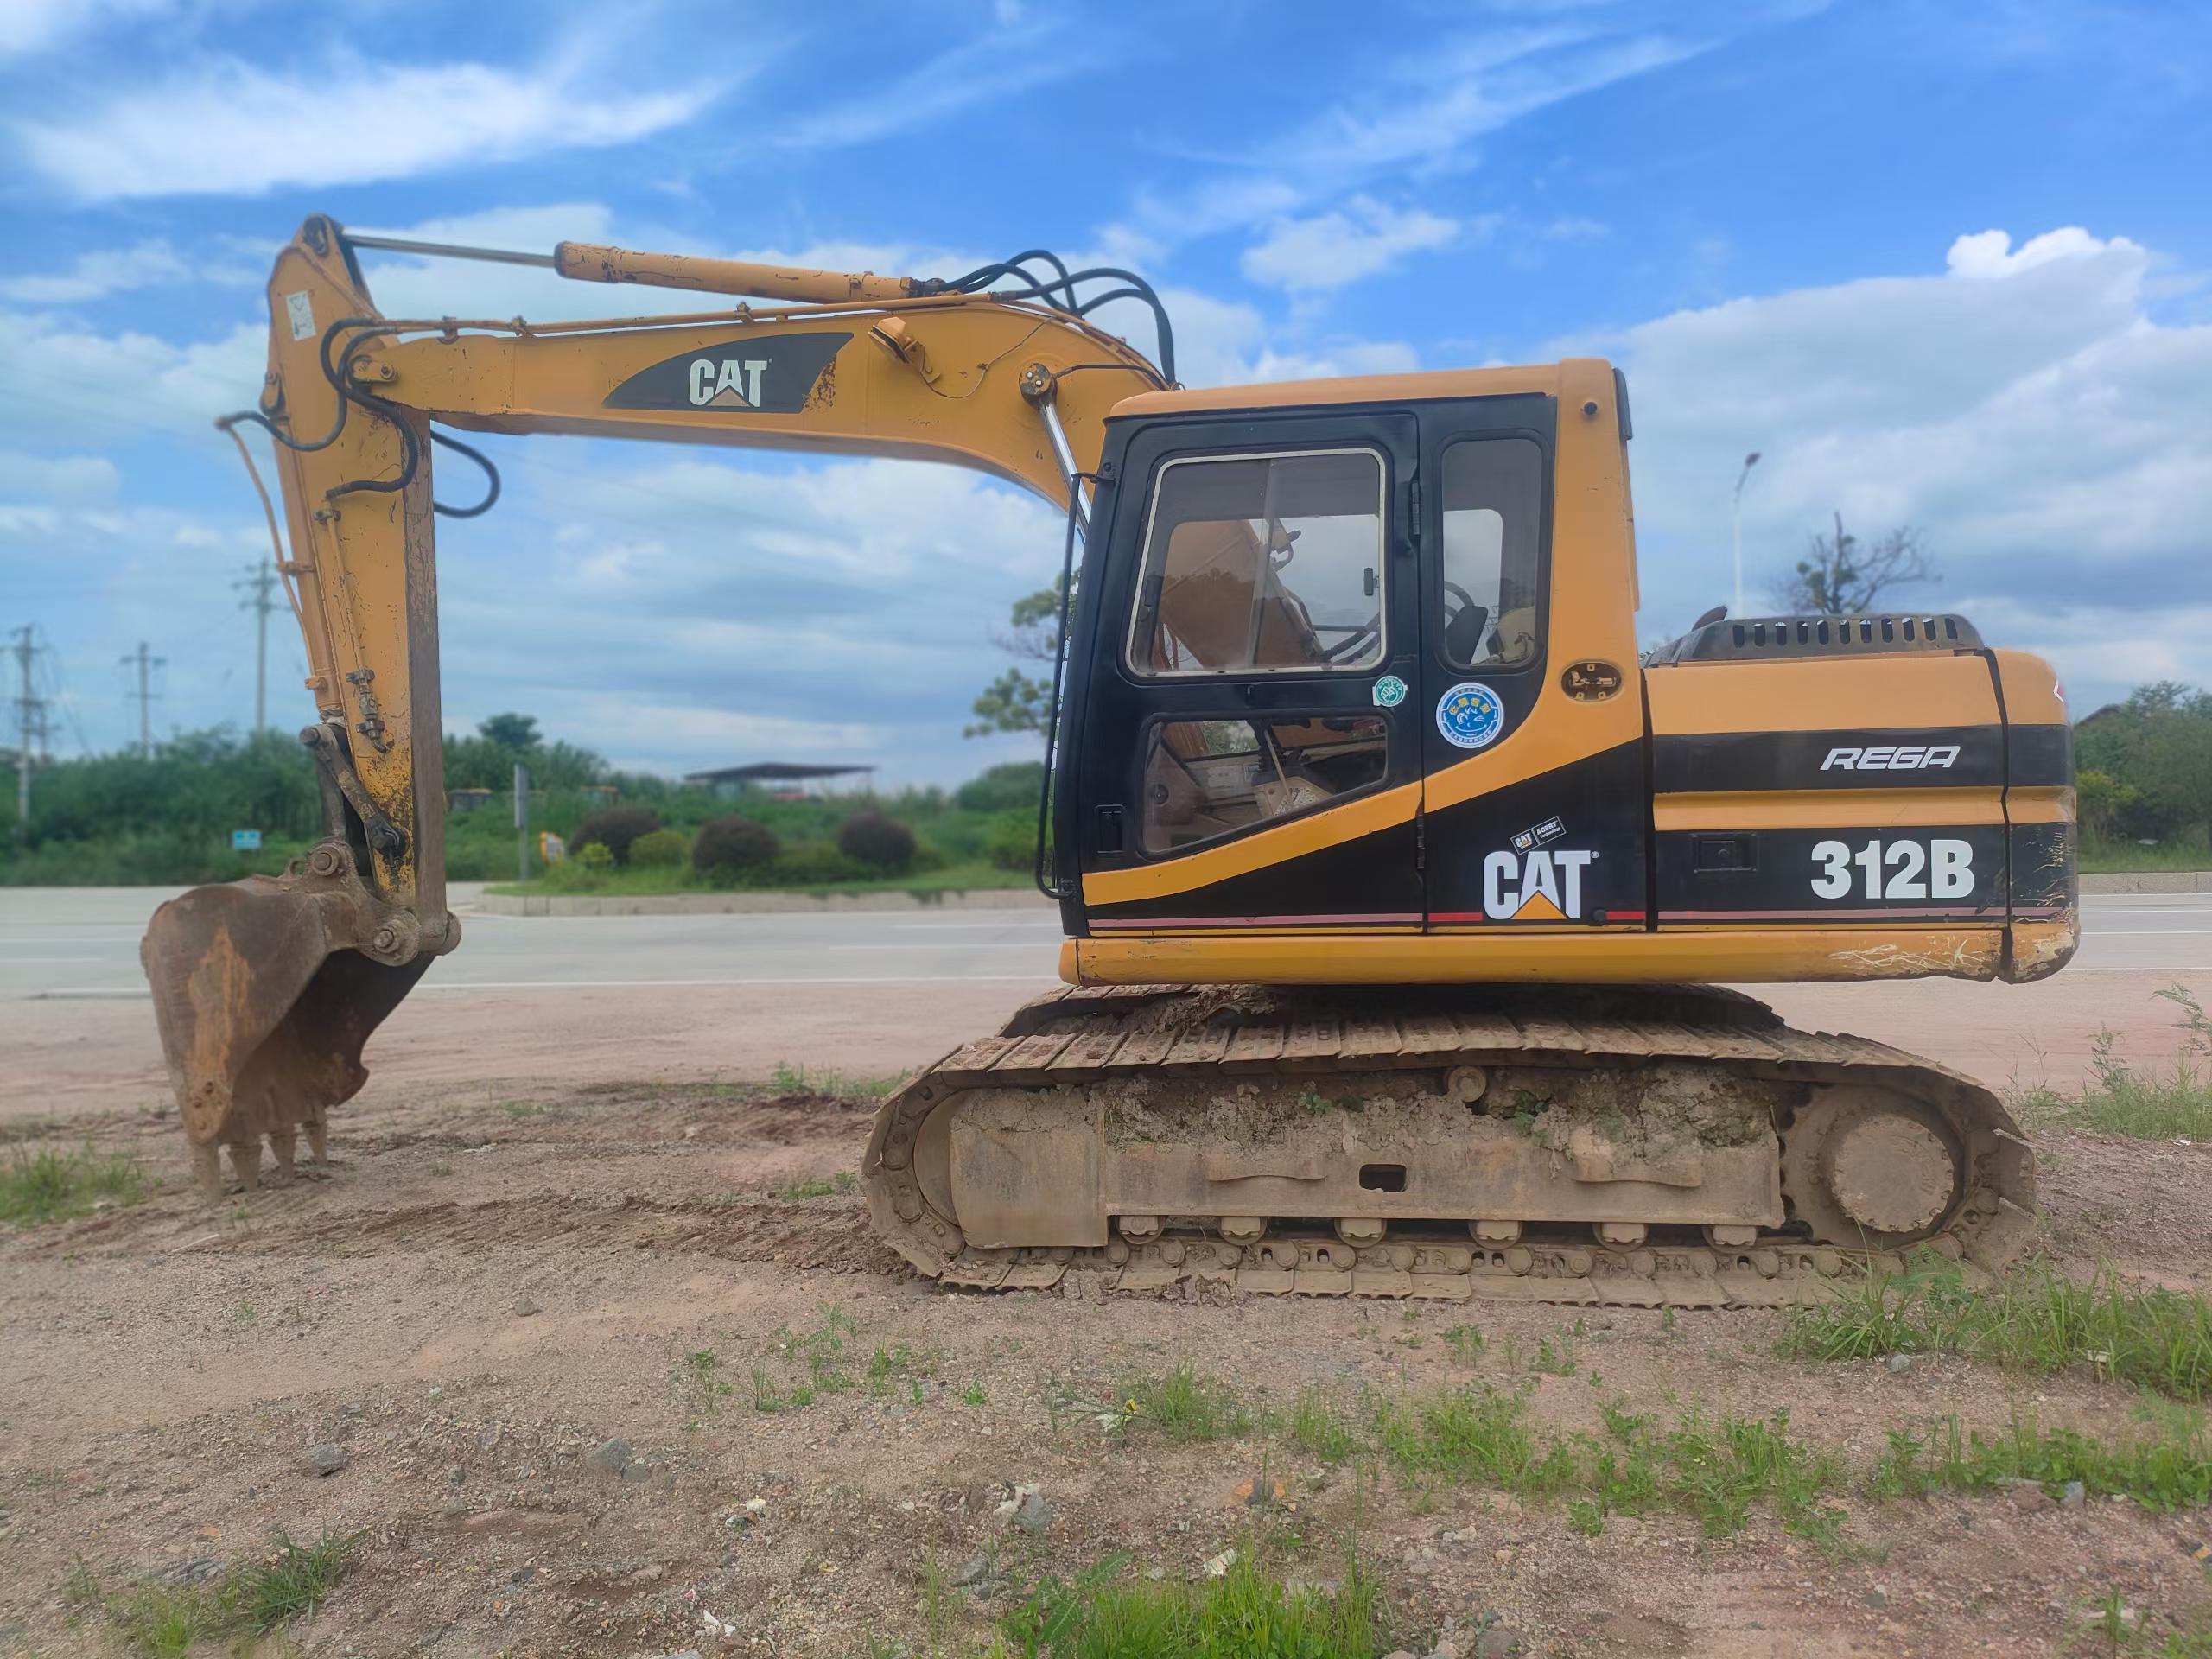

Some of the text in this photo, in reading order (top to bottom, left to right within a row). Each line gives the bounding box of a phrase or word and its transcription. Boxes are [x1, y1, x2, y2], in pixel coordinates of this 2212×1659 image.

[689, 359, 768, 408] CAT
[1820, 746, 1961, 770] REGA
[1515, 833, 1532, 848] CAT
[1536, 822, 1557, 836] ACERT
[1483, 850, 1592, 920] CAT
[1811, 840, 1975, 899] 312B
